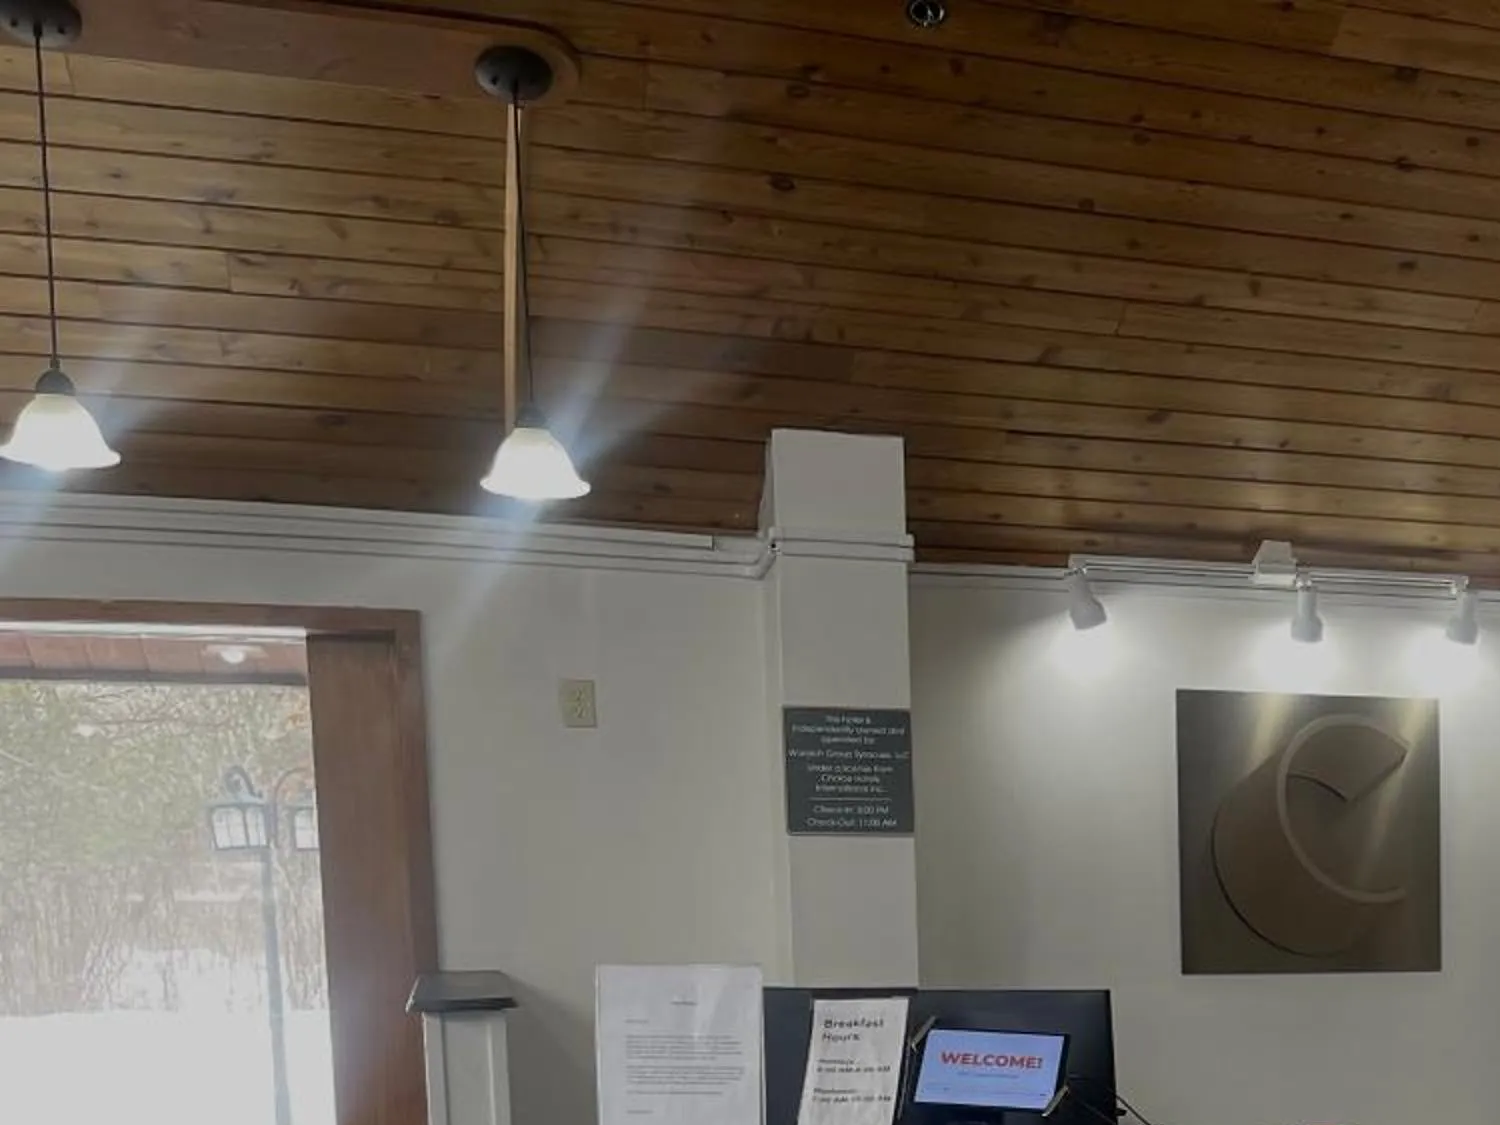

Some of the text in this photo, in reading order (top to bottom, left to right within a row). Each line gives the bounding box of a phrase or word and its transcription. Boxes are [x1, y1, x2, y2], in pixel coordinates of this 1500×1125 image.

[823, 1017, 885, 1029] Breakfast
[821, 1032, 861, 1043] Hours
[940, 1051, 1044, 1070] WELCOME!
